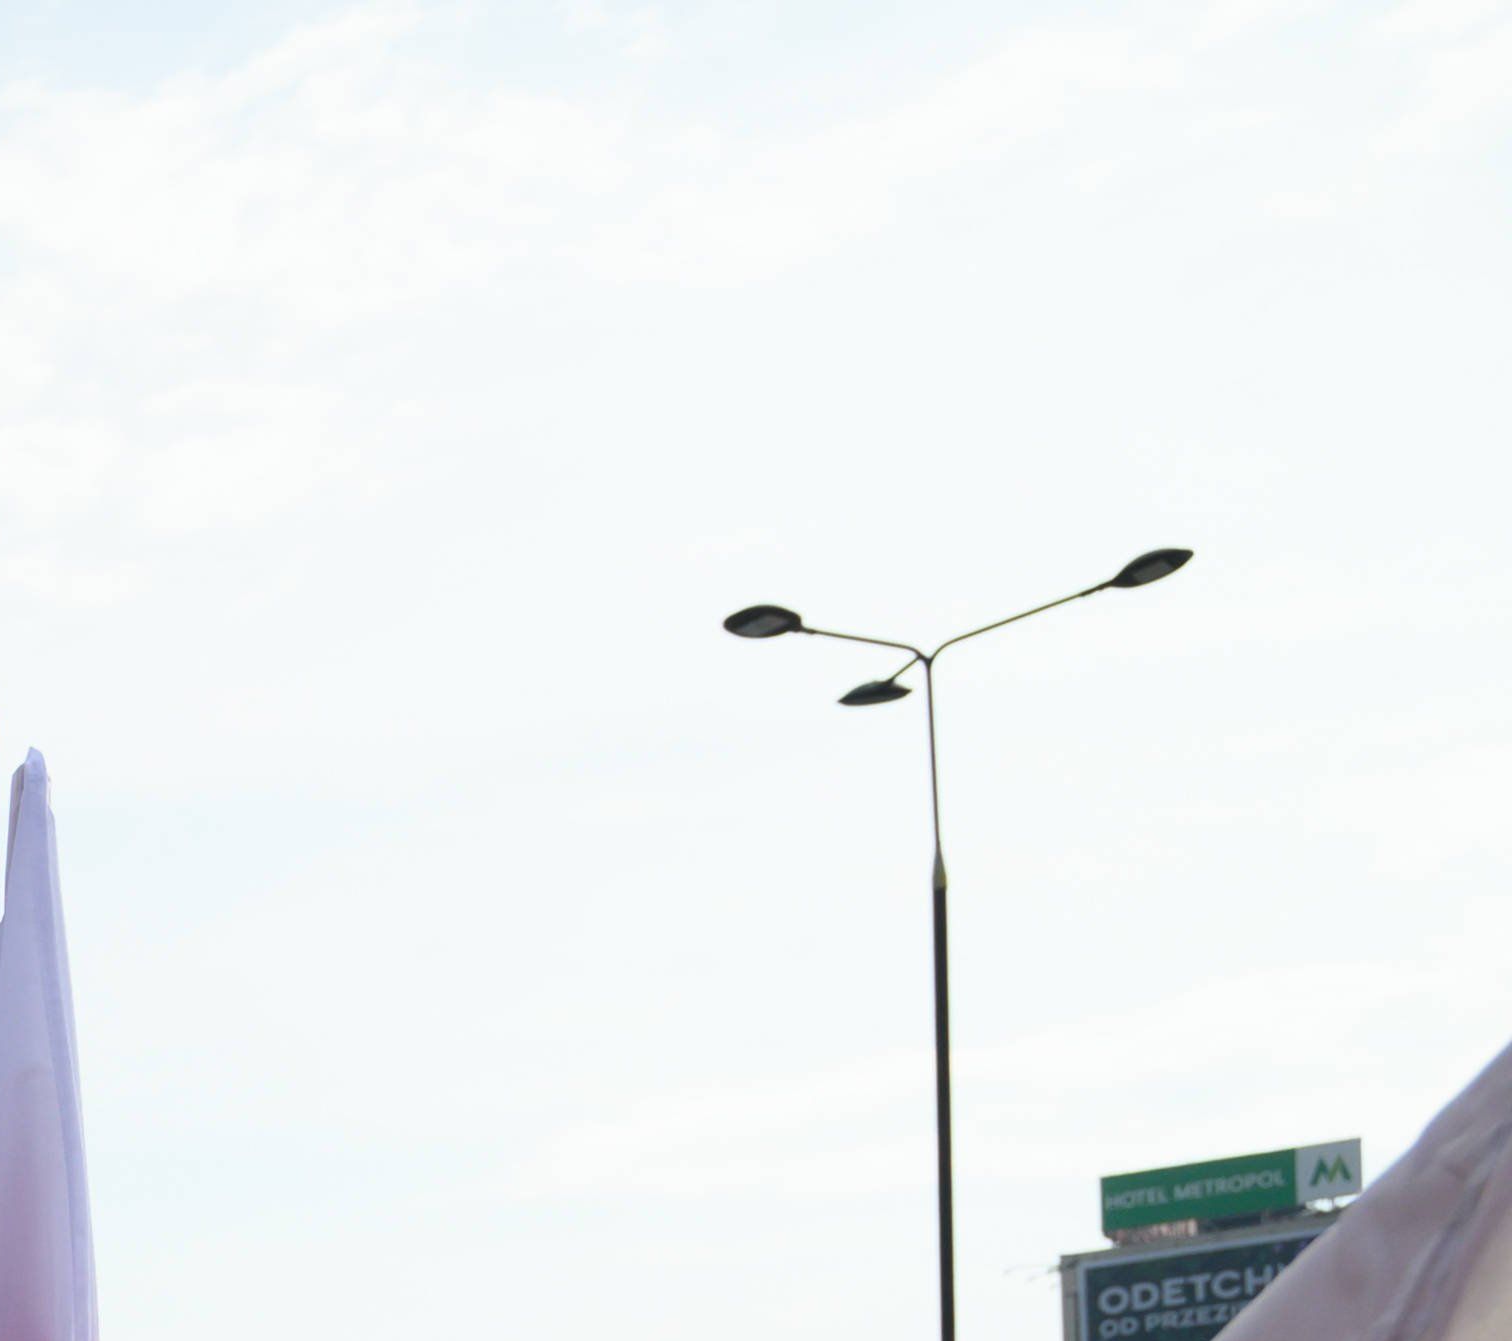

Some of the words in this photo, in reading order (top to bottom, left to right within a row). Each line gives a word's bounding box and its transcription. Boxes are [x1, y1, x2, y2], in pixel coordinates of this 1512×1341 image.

[1105, 1187, 1168, 1211] HOTEL
[1173, 1168, 1285, 1200] METROPOL
[1097, 1264, 1286, 1316] ODETCH
[1098, 1316, 1140, 1340] OD
